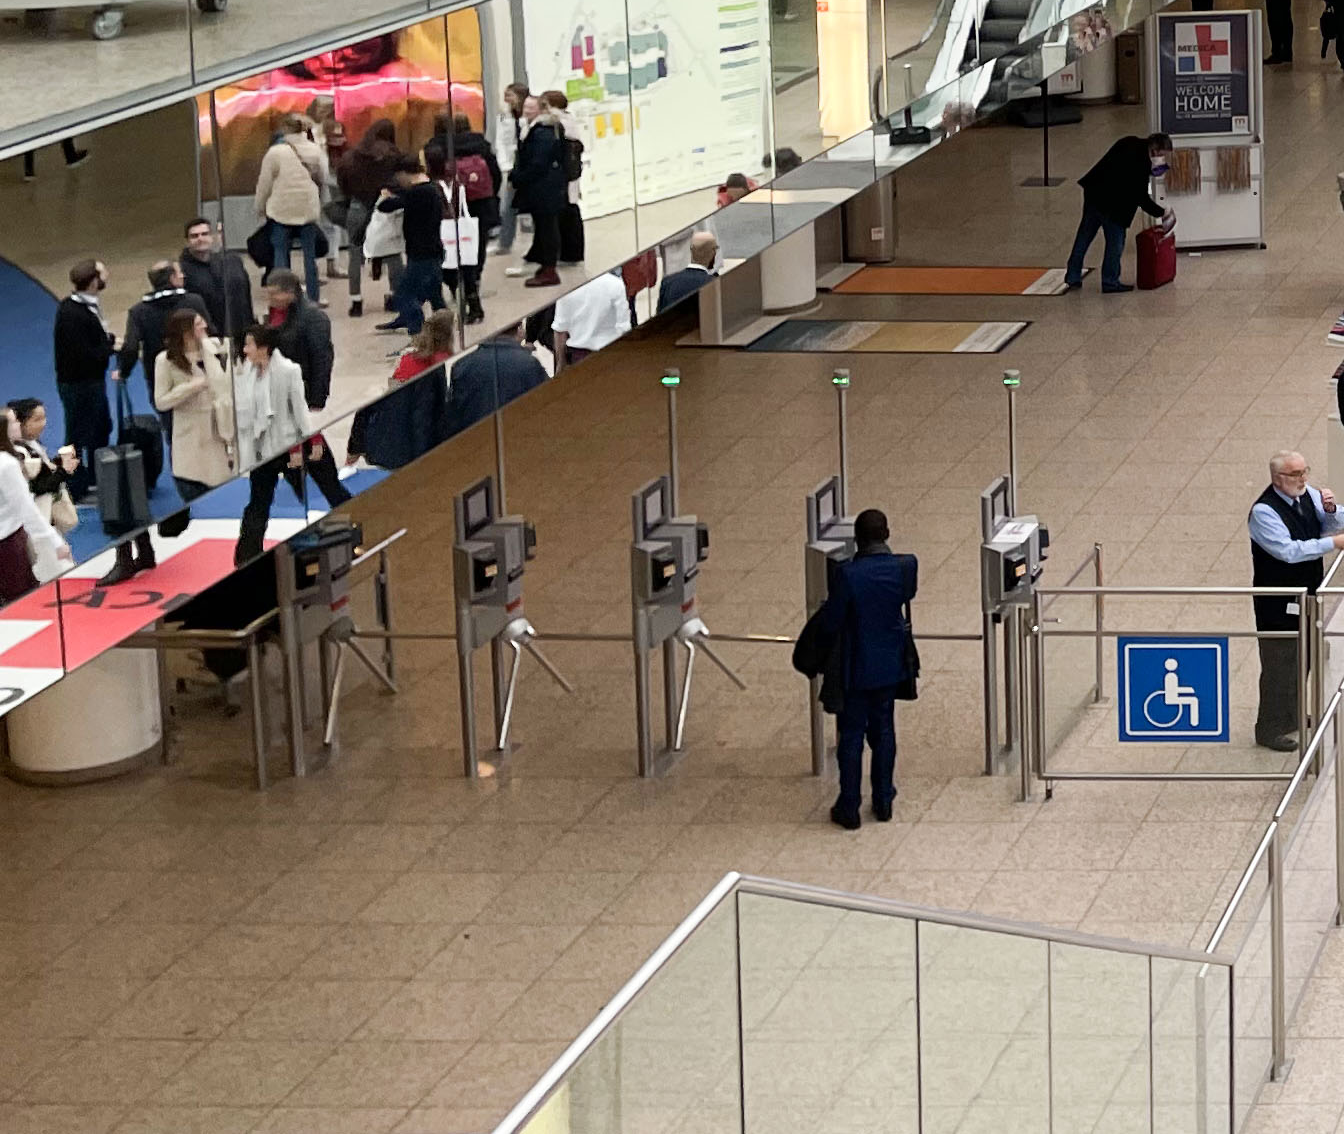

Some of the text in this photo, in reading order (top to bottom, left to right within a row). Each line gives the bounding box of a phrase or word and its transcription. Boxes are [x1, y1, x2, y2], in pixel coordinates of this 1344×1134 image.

[1177, 44, 1217, 52] MEDICA
[1175, 85, 1232, 96] WELCOME
[1175, 95, 1232, 112] HOME
